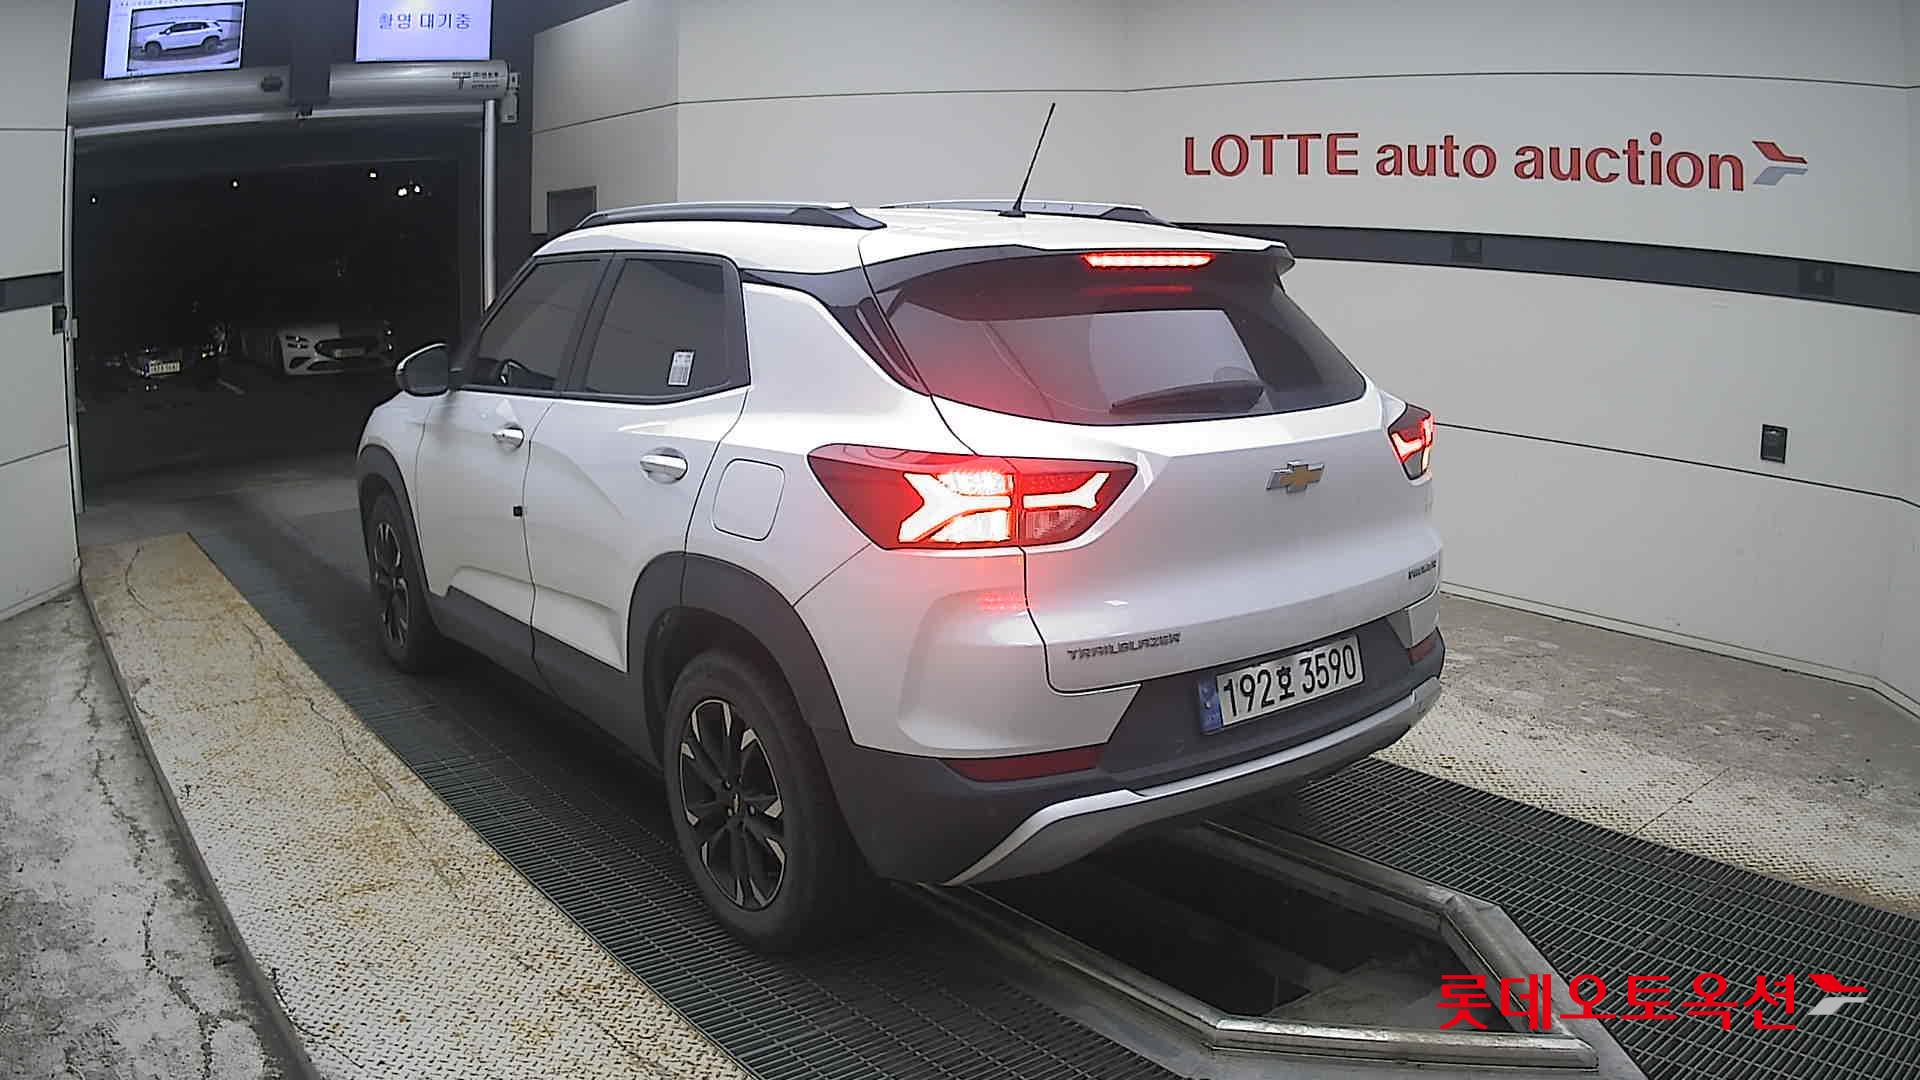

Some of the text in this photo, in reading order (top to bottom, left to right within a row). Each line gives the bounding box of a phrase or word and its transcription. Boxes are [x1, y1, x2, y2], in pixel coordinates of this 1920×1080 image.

[420, 13, 472, 30] 대기중
[1184, 132, 1745, 192] LOTTE auto auction
[1067, 632, 1181, 660] TRAILBLAZER
[1223, 644, 1356, 717] 192호 3590
